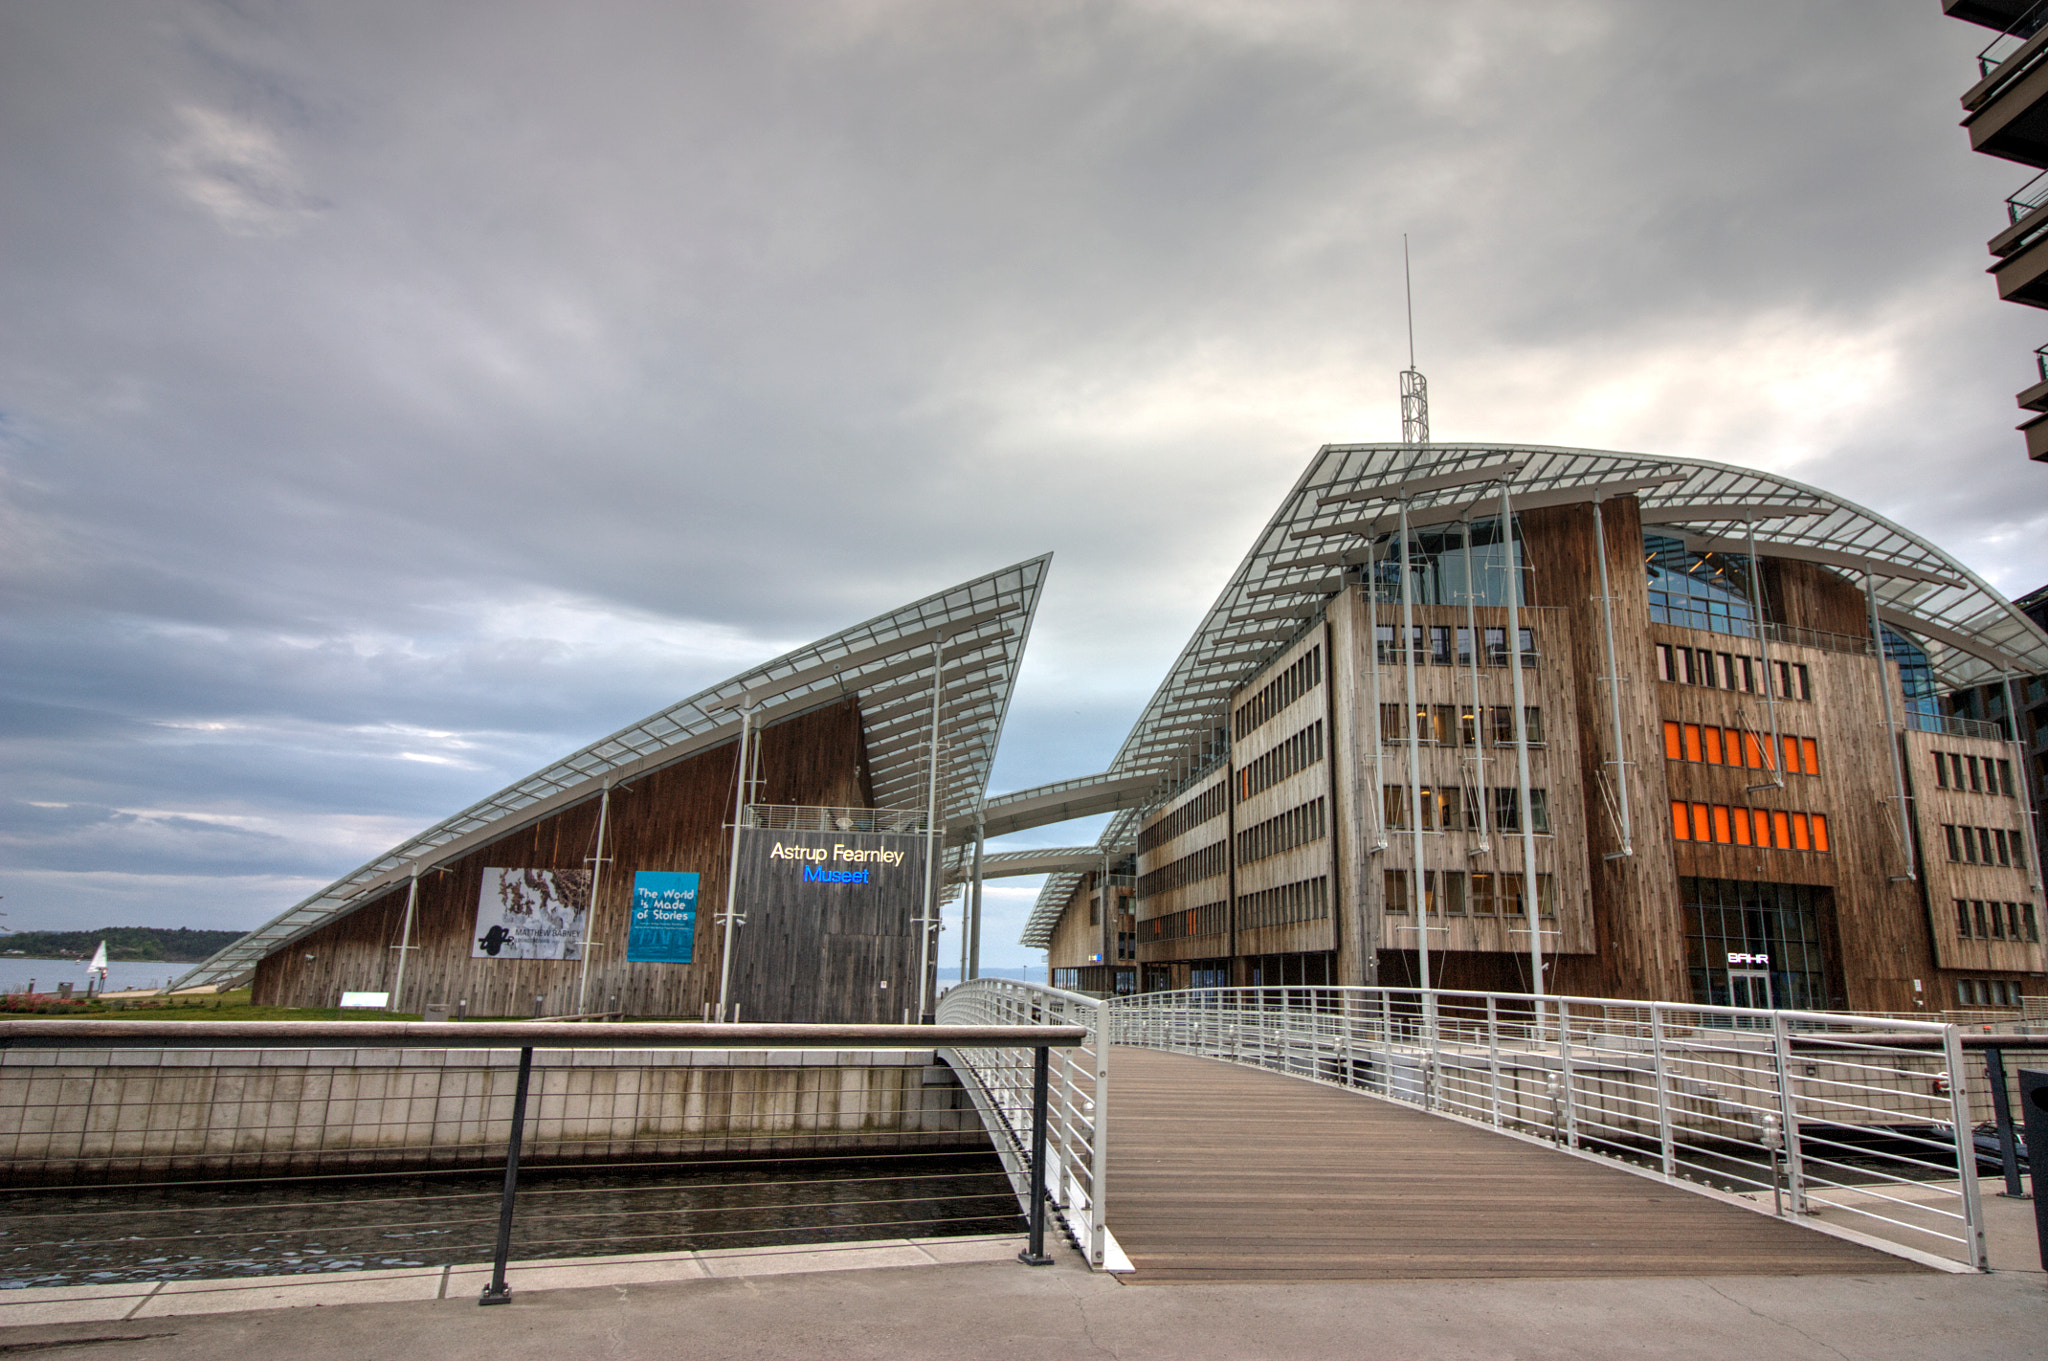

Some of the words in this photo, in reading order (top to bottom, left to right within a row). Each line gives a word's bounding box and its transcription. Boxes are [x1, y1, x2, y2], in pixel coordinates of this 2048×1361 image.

[770, 842, 828, 864] Astrup
[833, 844, 905, 867] Fearnley
[804, 865, 869, 884] Museet
[638, 888, 658, 899] The
[663, 889, 695, 900] World
[654, 900, 686, 910] Made
[637, 909, 649, 920] of
[653, 909, 688, 921] Stories
[515, 928, 551, 937] MATTHEW
[552, 929, 581, 938] BARNEY
[1727, 952, 1769, 964] BAHR
